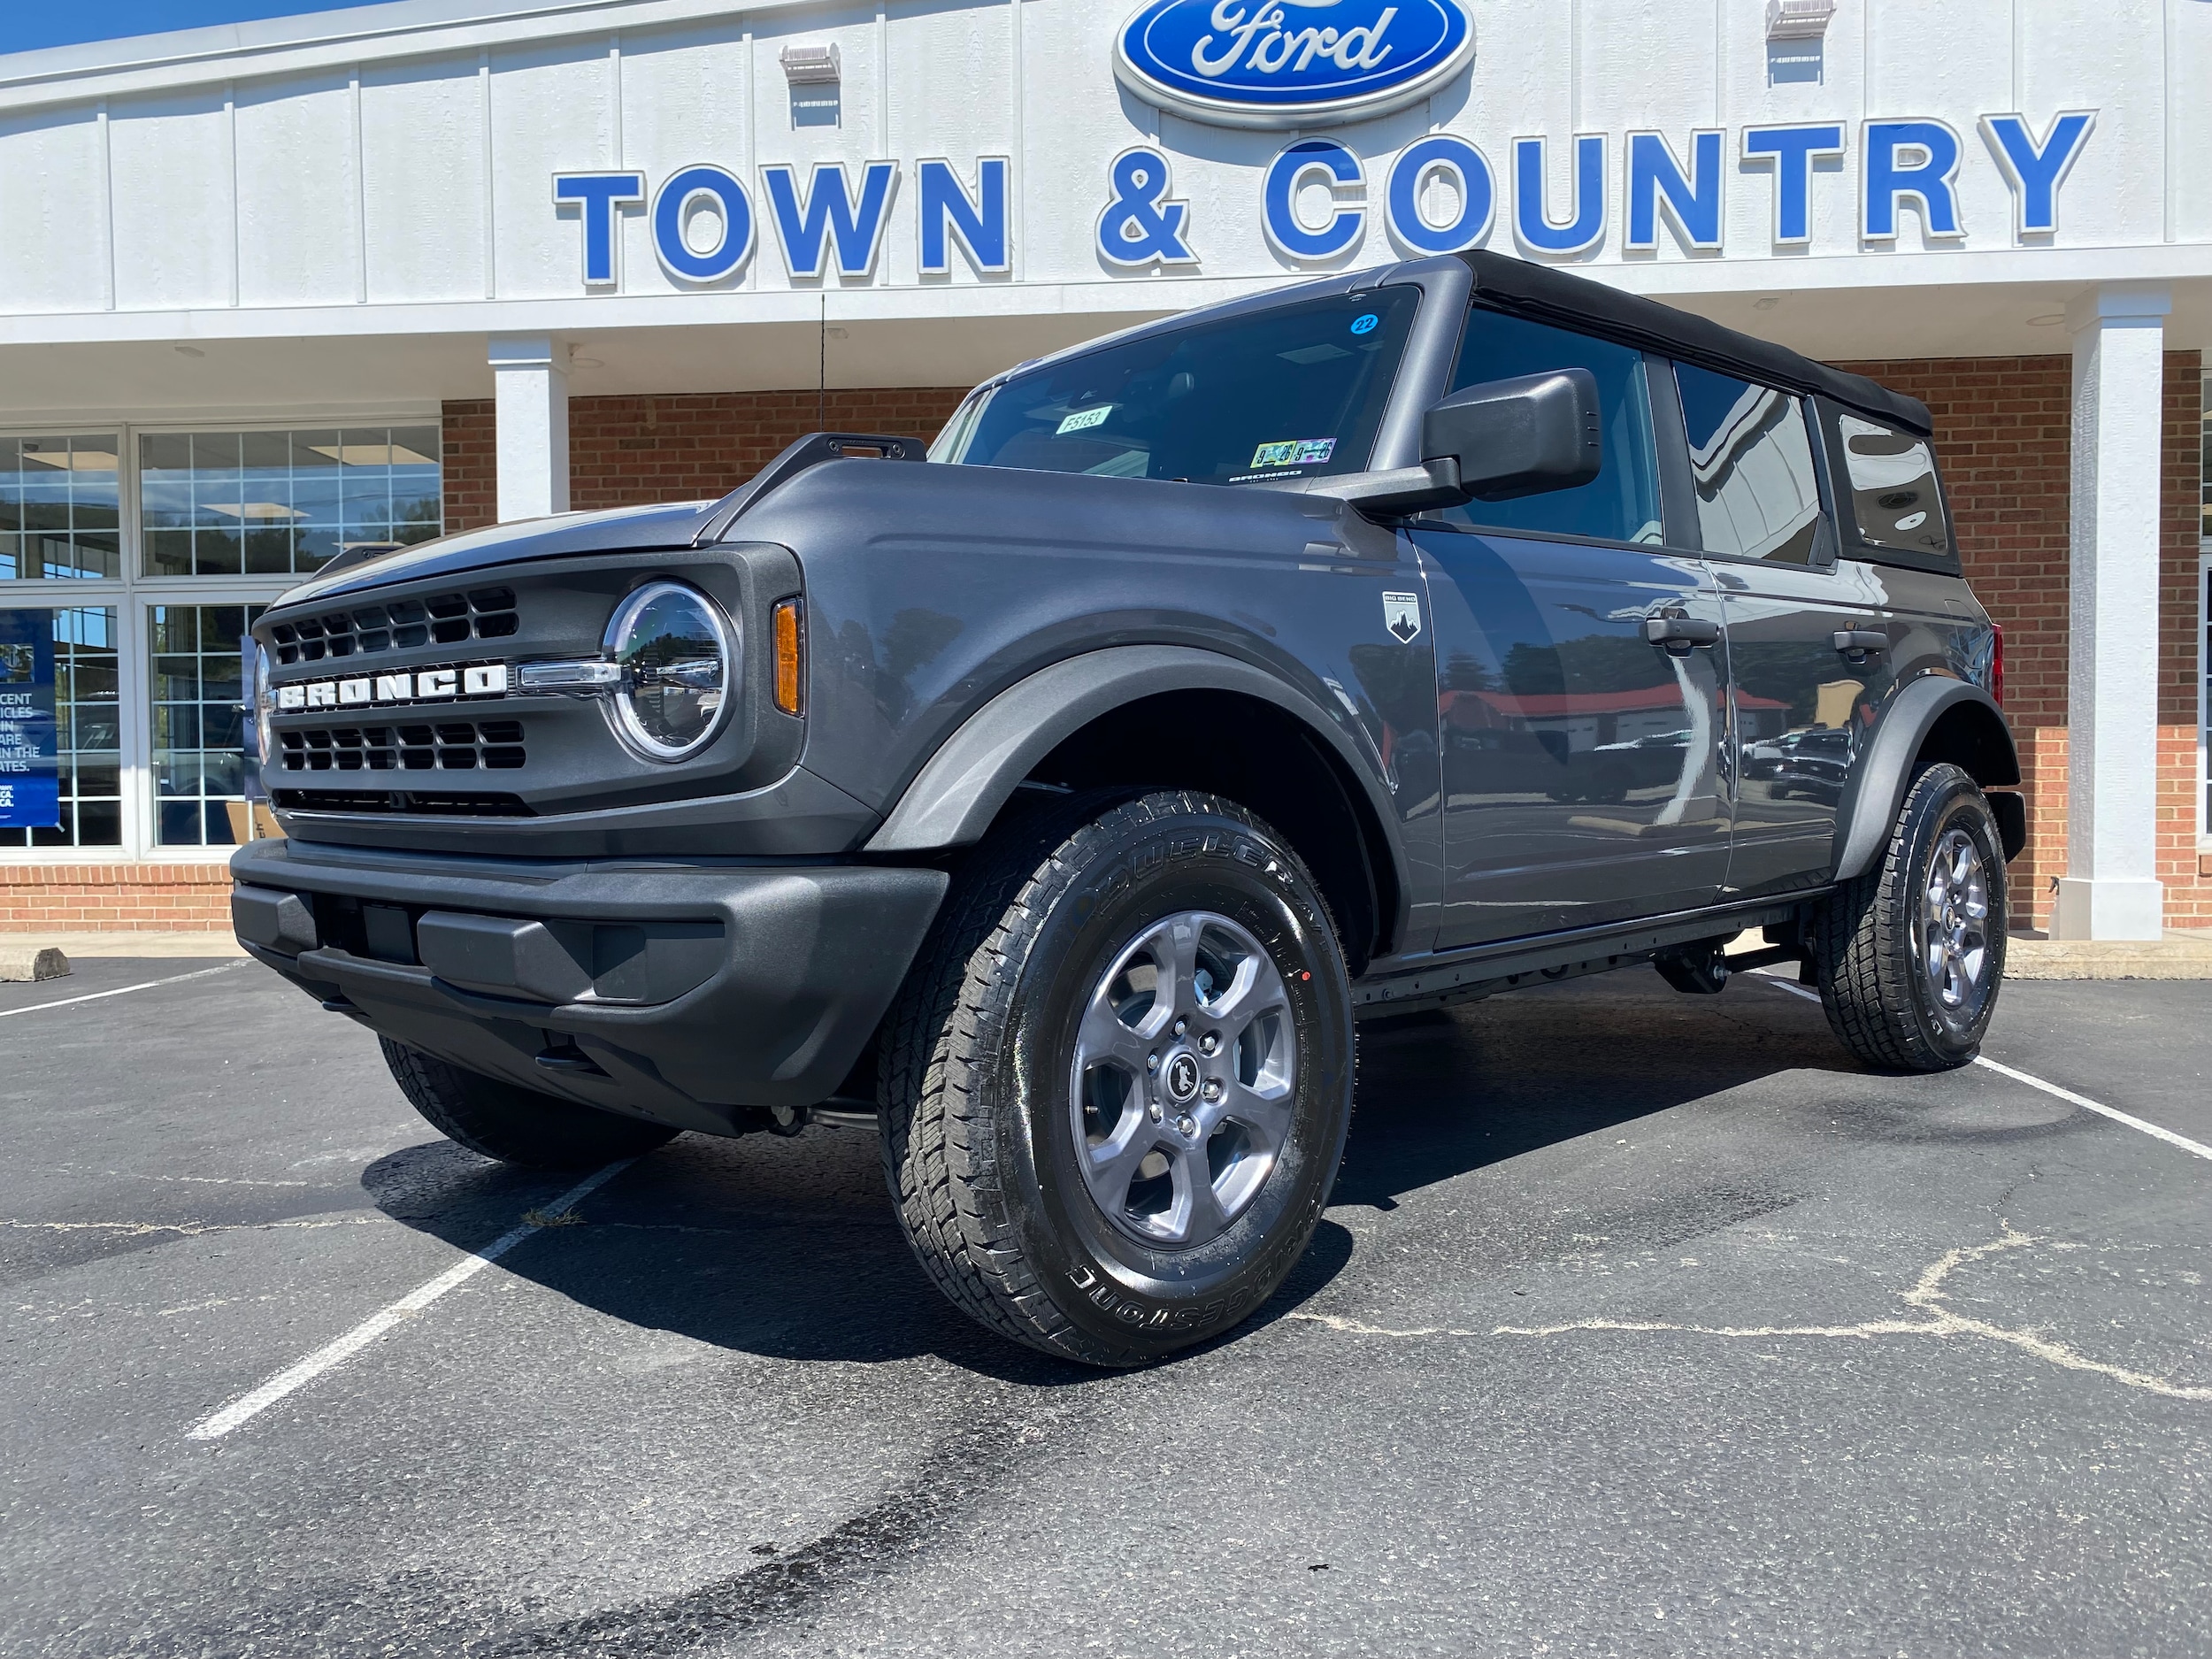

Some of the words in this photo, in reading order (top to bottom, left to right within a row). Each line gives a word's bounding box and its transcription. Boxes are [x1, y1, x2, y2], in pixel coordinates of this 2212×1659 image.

[1191, 0, 1399, 77] Ford
[552, 156, 1010, 286] TOWN
[1094, 145, 1202, 266] &
[1262, 108, 2100, 260] COUNTRY
[1355, 318, 1374, 332] 22
[1063, 411, 1102, 432] F5153
[279, 664, 508, 710] BRONCO
[14, 746, 41, 758] THE
